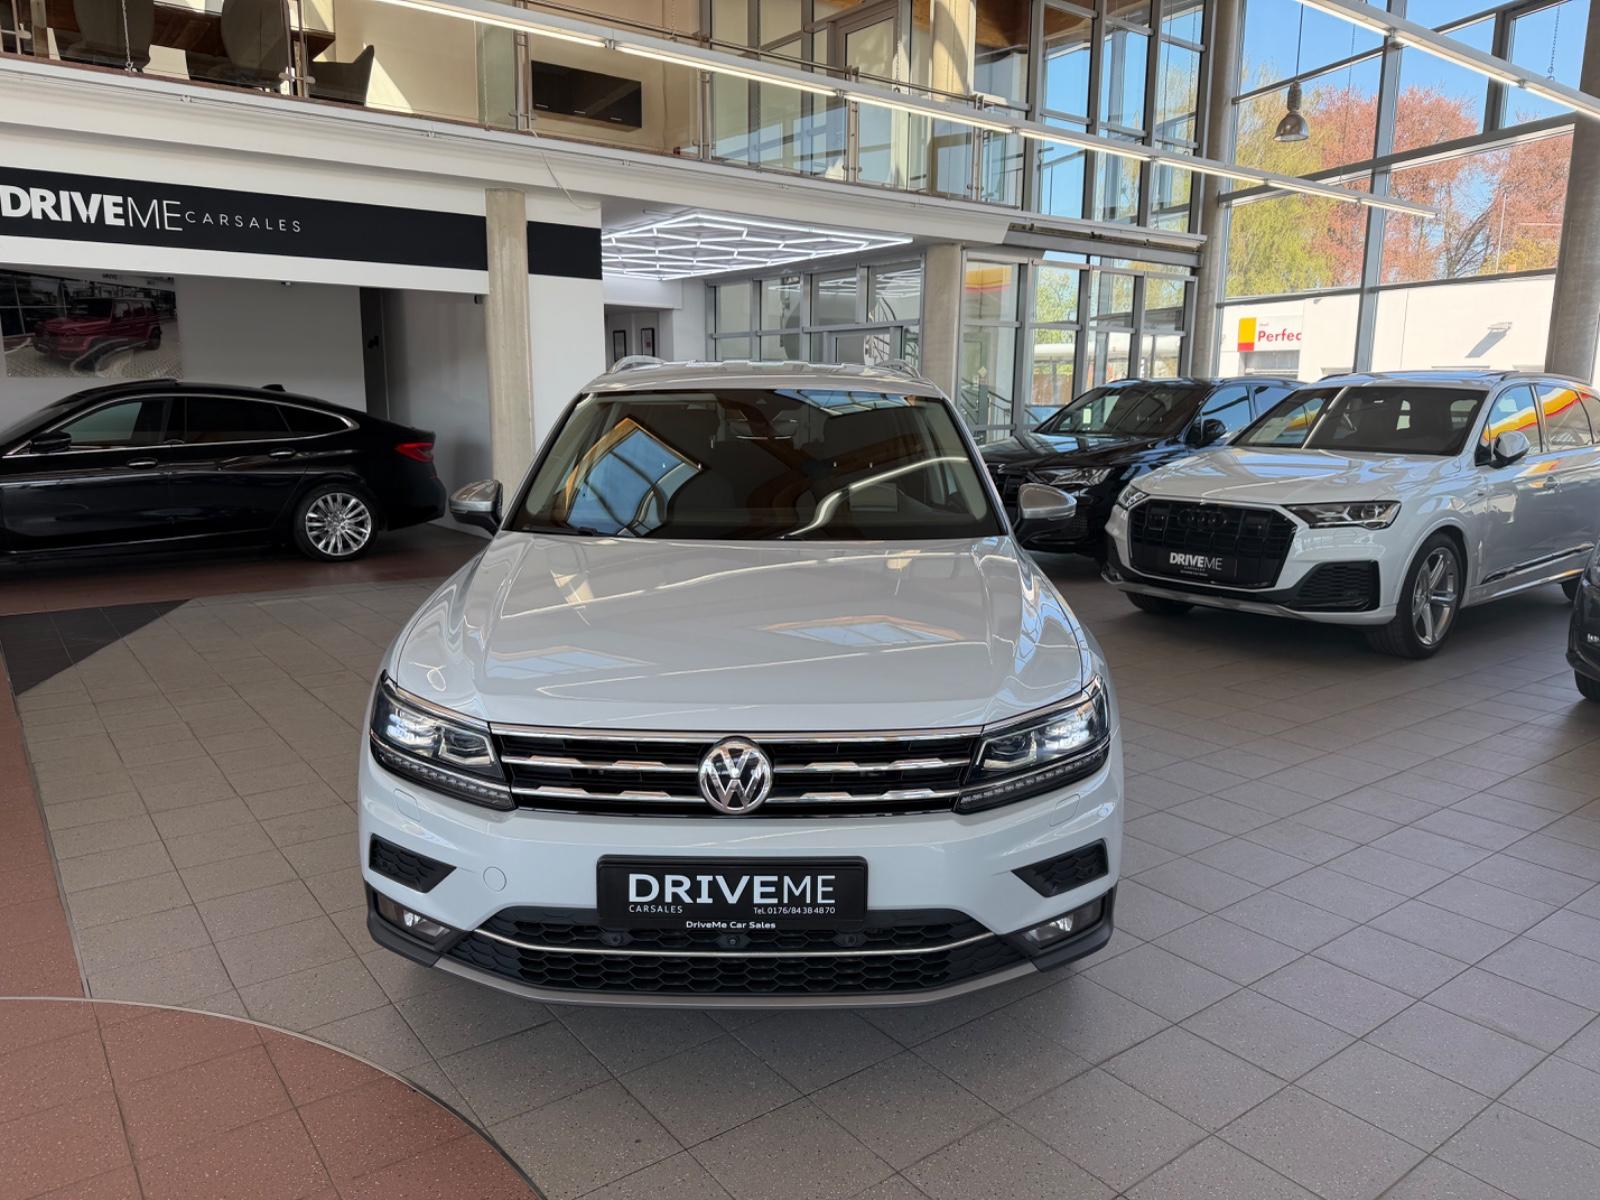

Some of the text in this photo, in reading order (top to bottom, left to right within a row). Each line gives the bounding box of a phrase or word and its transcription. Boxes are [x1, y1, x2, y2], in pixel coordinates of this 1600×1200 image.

[0, 184, 301, 233] DRIVEME CARSALES
[1169, 552, 1223, 570] DRIVEME
[702, 741, 768, 811] VW
[628, 873, 837, 904] DRIVEME
[628, 904, 684, 914] CARSALES
[686, 921, 776, 929] DriveMe Car Sales
